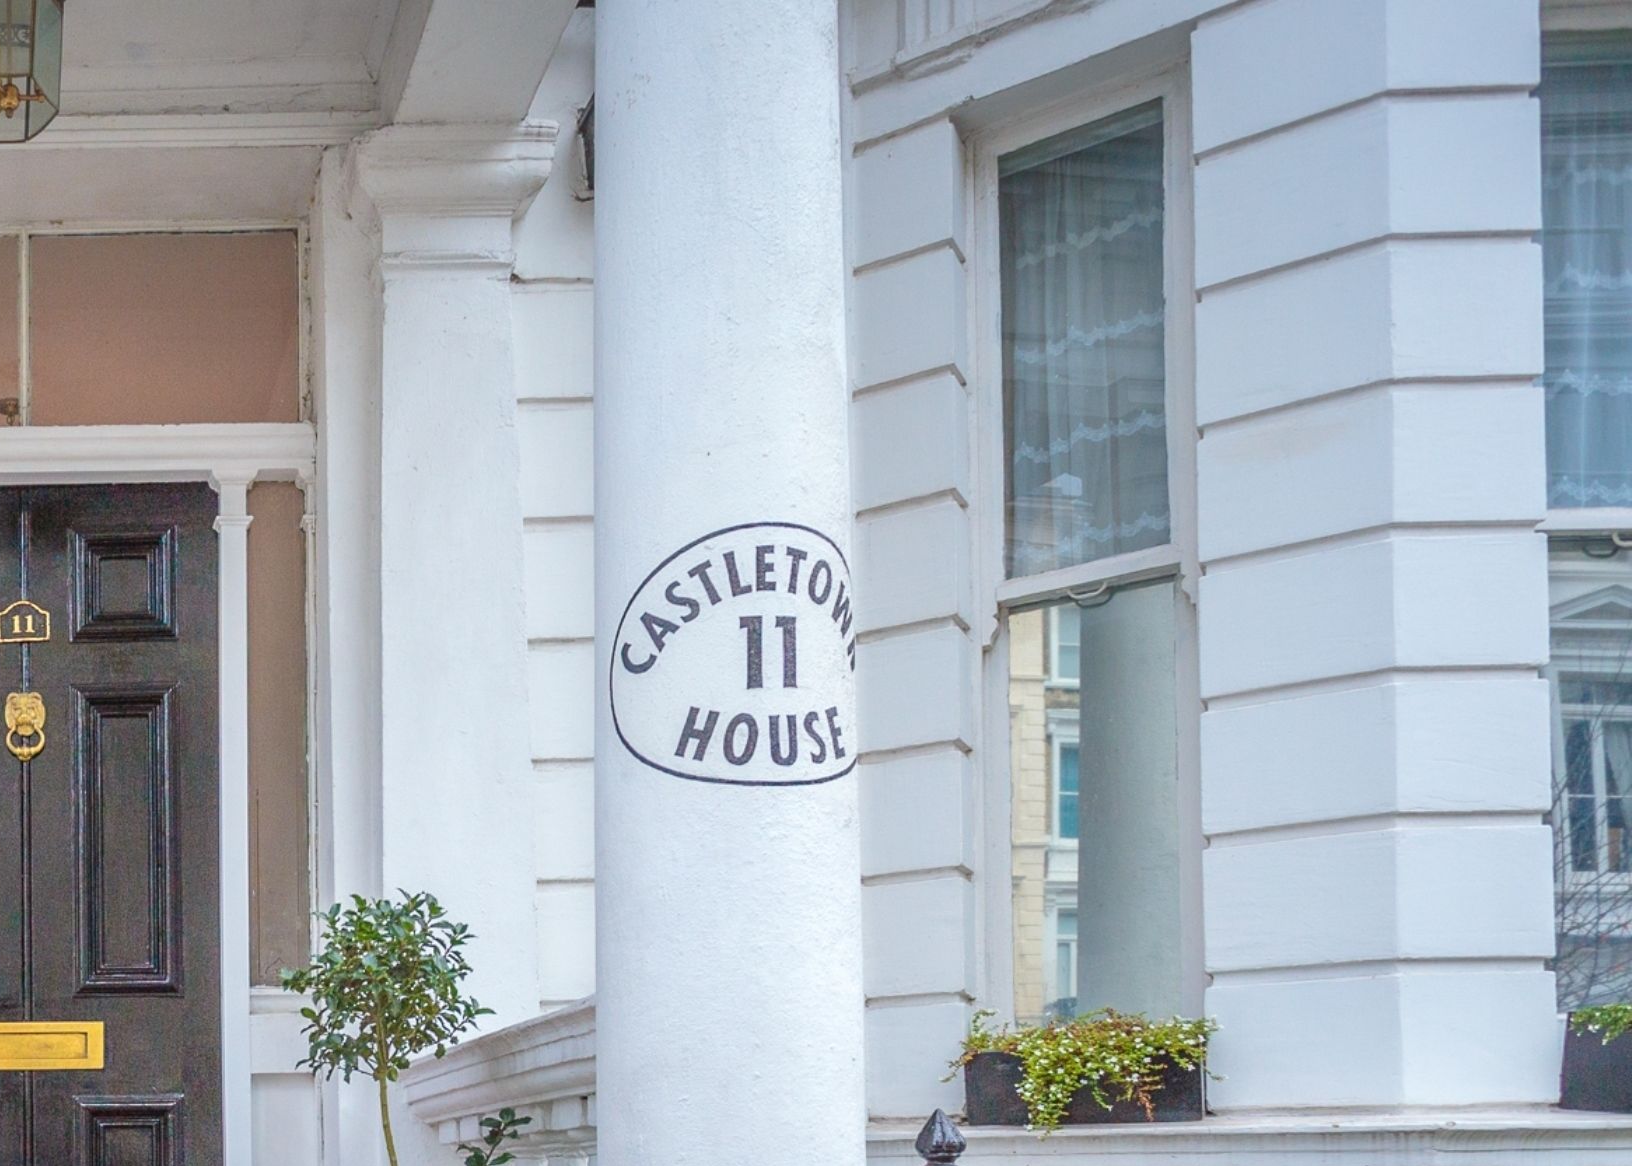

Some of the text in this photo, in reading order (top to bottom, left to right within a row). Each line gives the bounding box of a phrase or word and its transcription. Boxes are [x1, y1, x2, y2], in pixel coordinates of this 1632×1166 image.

[11, 614, 36, 633] 11
[739, 615, 798, 690] 11
[674, 706, 846, 766] HOUSE
